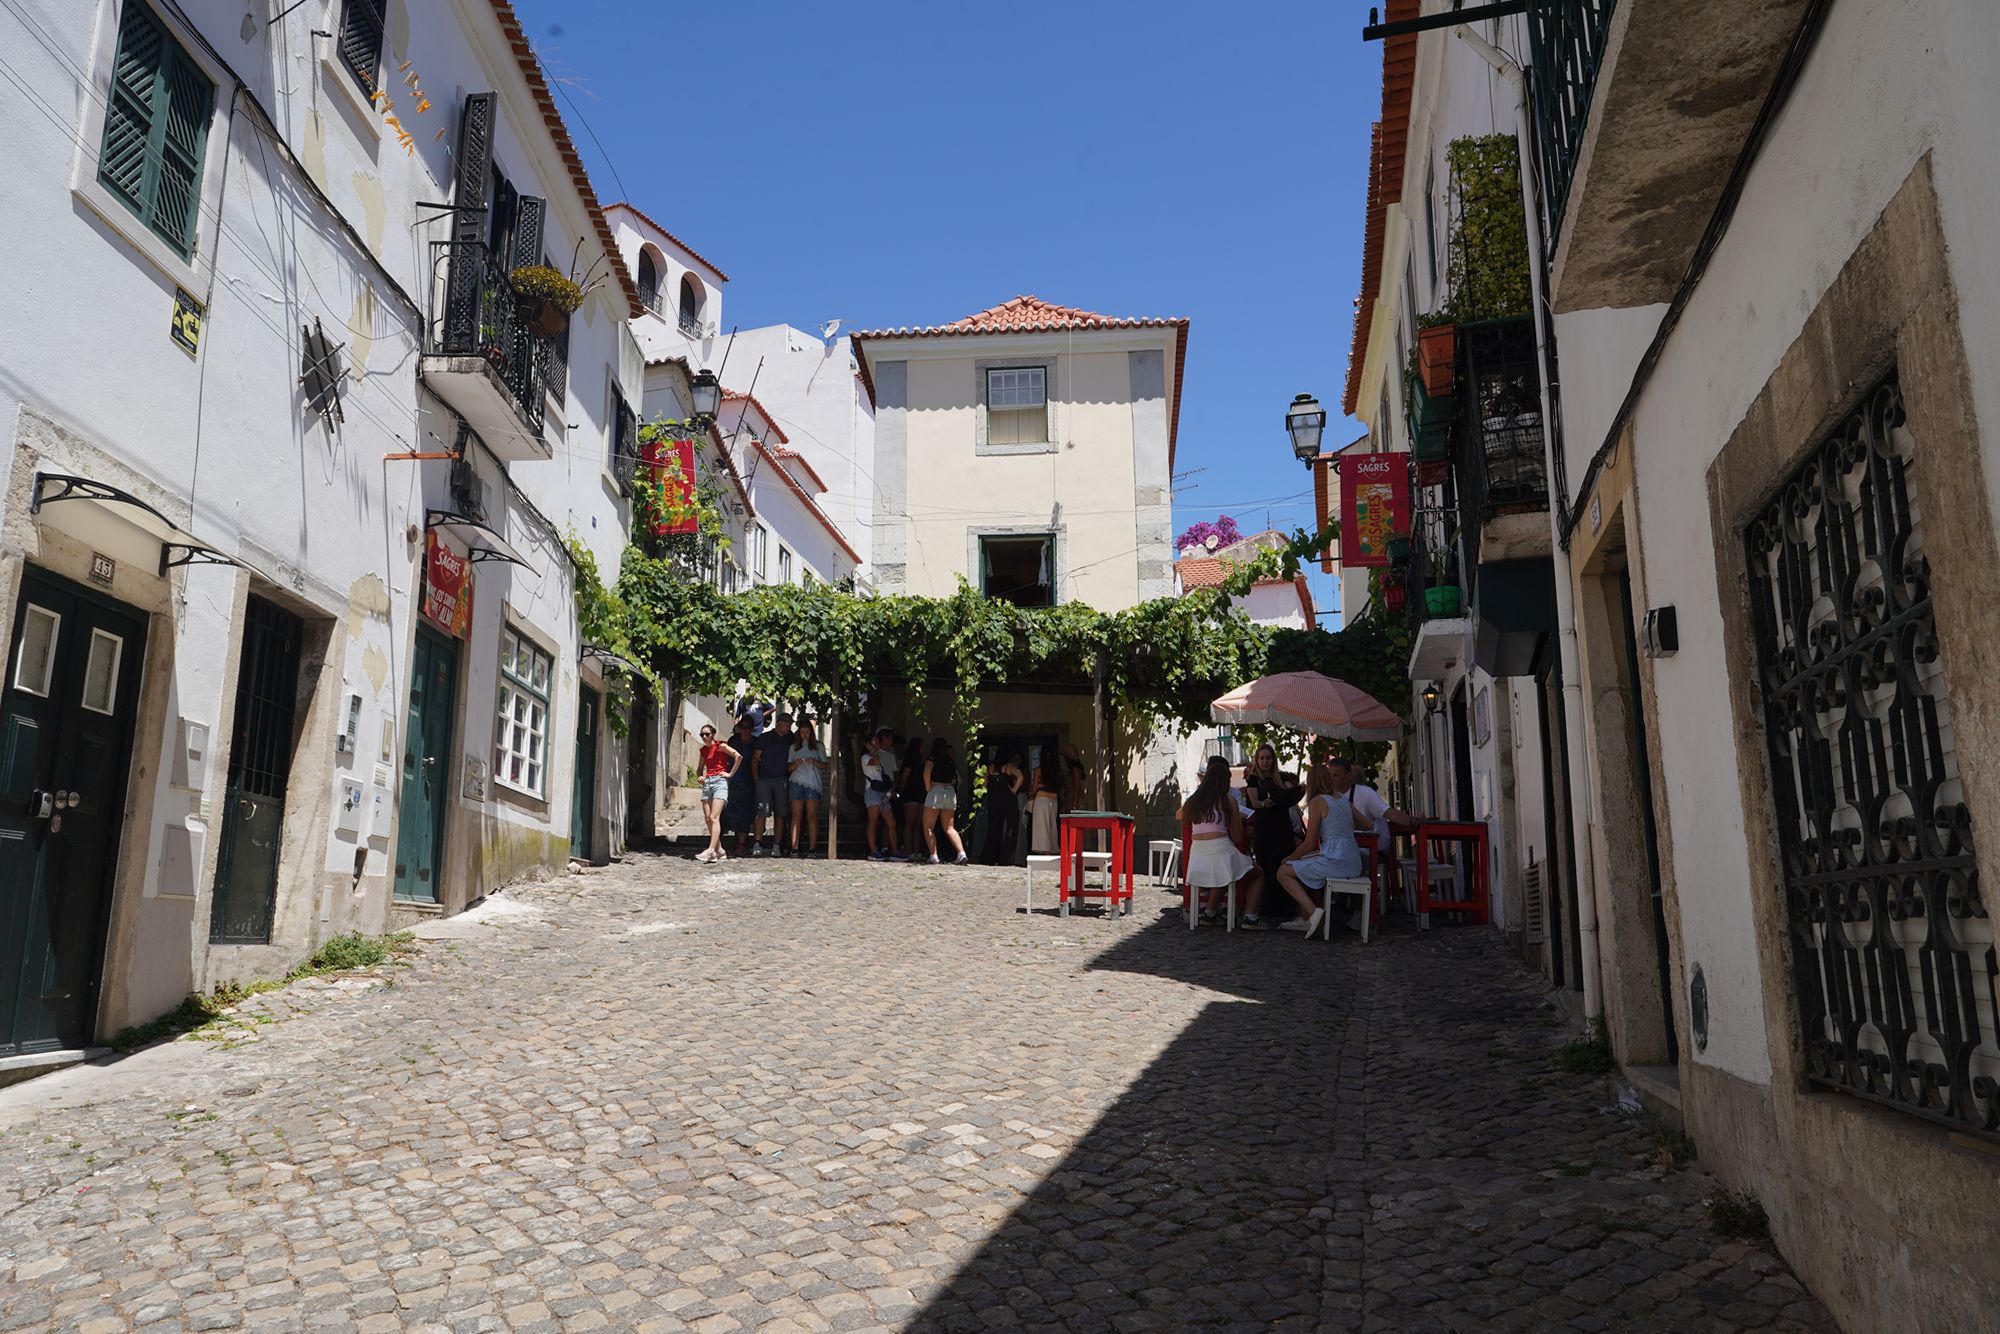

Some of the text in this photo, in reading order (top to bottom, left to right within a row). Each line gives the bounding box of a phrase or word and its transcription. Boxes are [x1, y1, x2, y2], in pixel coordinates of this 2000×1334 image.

[1357, 462, 1390, 473] SAGRES
[1368, 494, 1382, 534] SAGRES
[97, 561, 110, 576] 43
[434, 551, 461, 577] SAGRES
